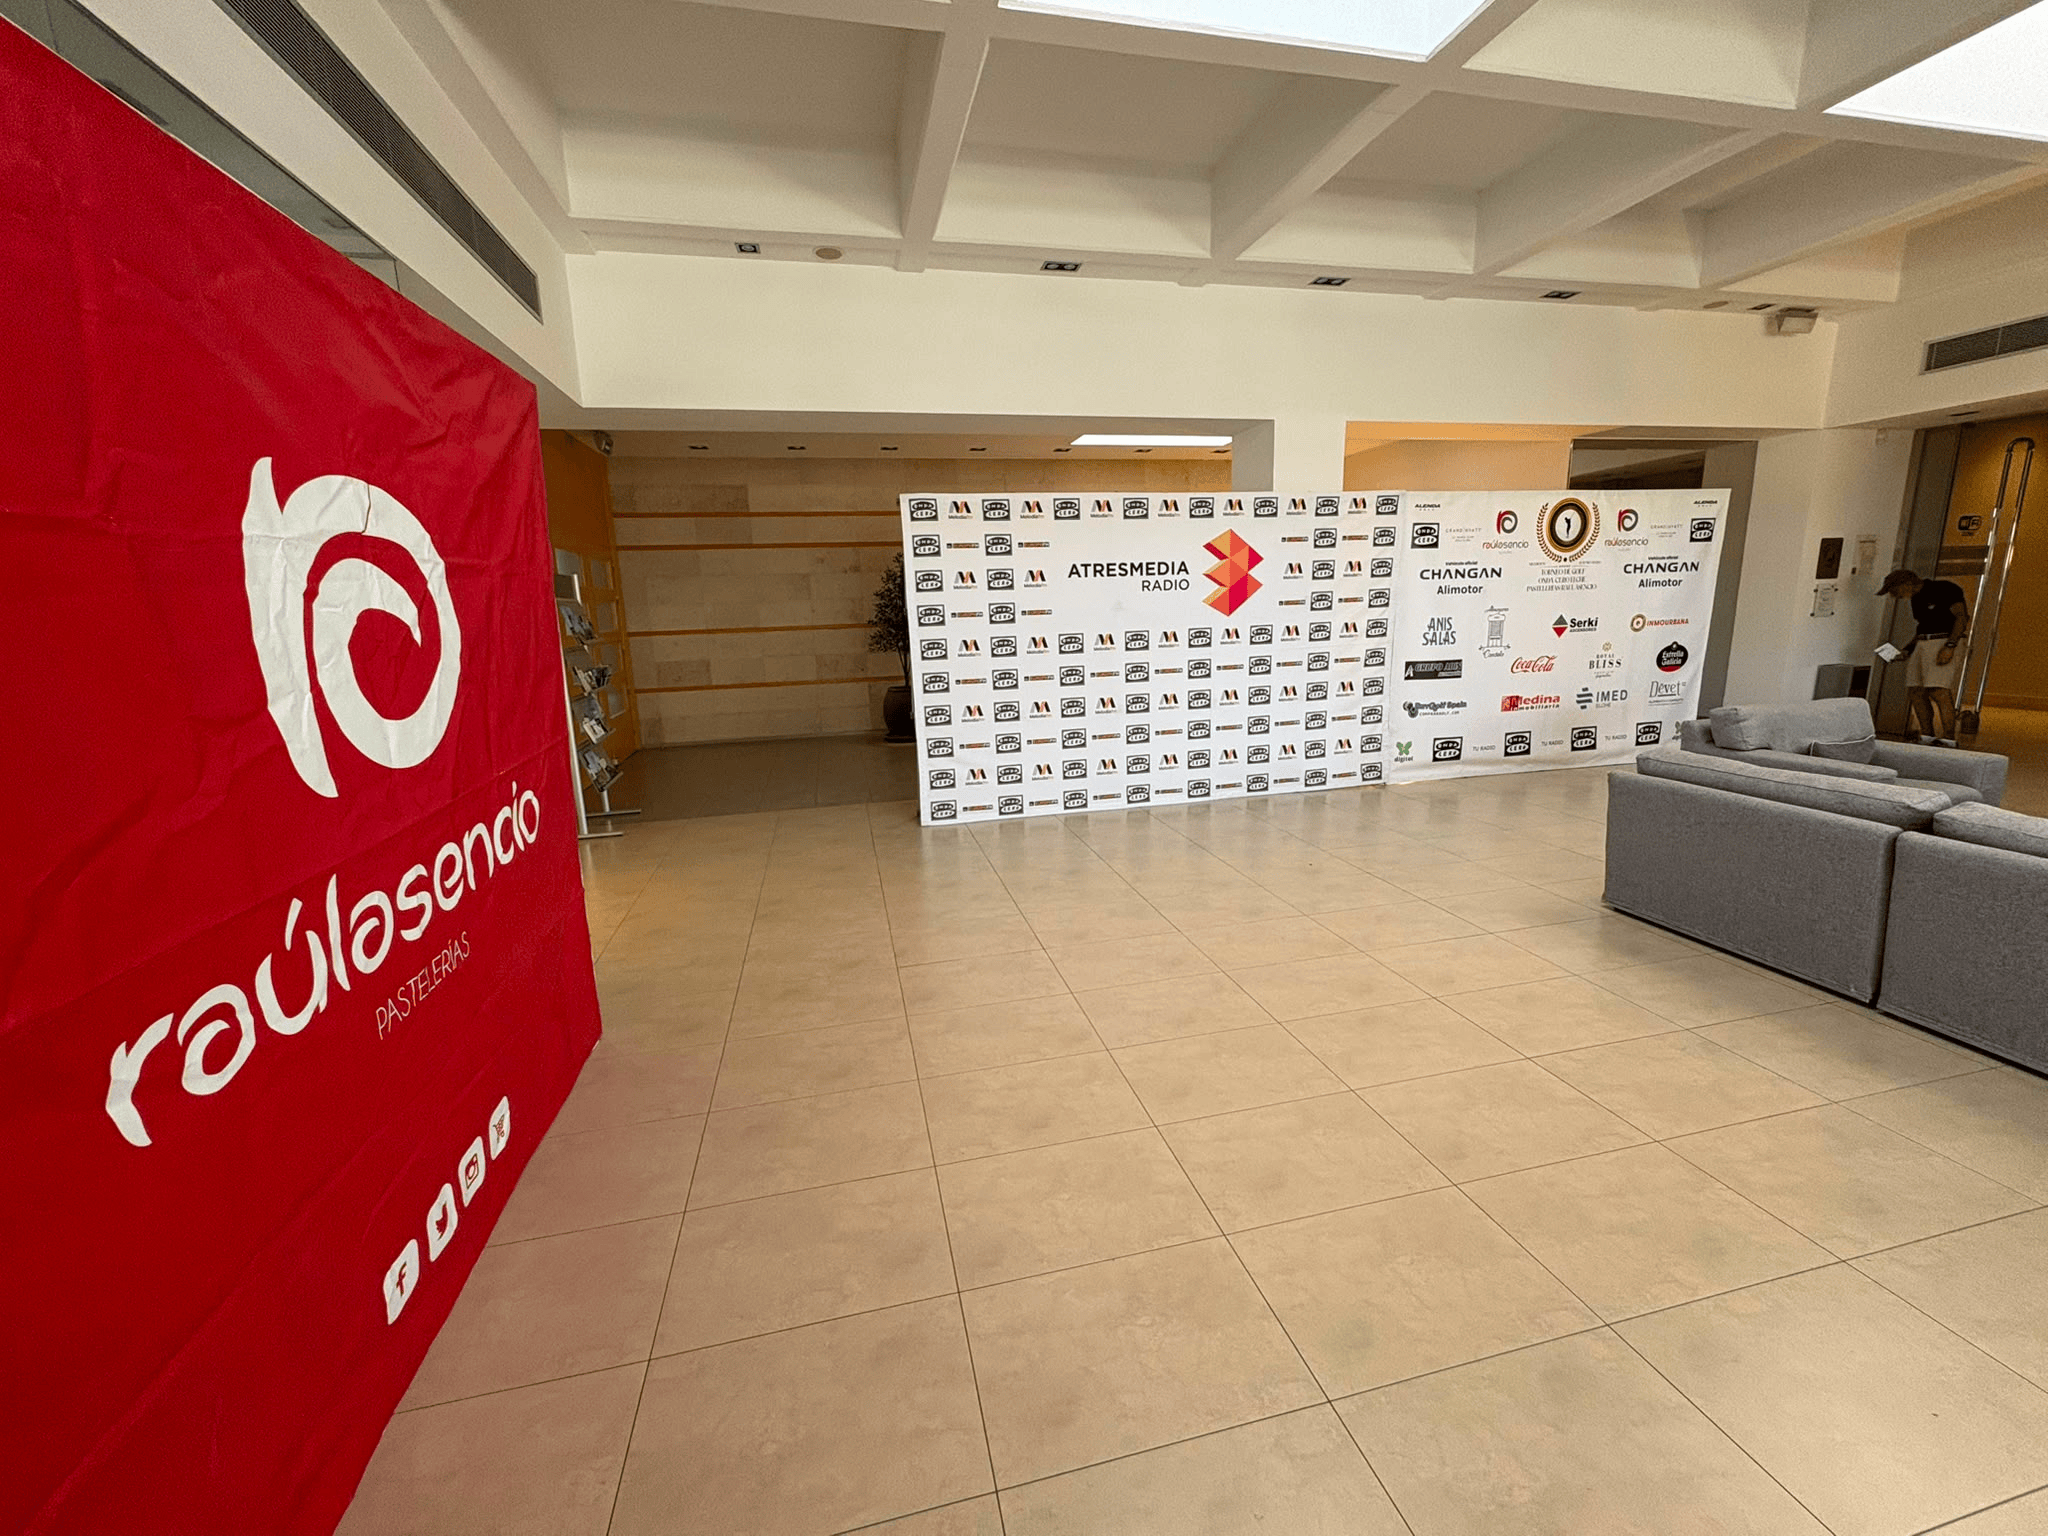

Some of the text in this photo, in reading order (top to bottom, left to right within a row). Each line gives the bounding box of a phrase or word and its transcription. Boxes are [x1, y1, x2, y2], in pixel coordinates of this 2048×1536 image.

[1068, 561, 1189, 578] ATRESMEDIA
[1419, 567, 1502, 580] CHANGAN
[1623, 561, 1700, 574] CHANGAN
[1141, 579, 1190, 592] RADIO
[1638, 578, 1683, 588] Alimotor
[1437, 585, 1483, 595] Alimotor
[1427, 616, 1453, 632] ANIS
[1569, 617, 1599, 628] Serki
[1422, 630, 1456, 646] SALAS
[1588, 659, 1622, 670] BLISS
[1596, 690, 1628, 702] IMED
[375, 931, 470, 1040] PASTELERÍAS
